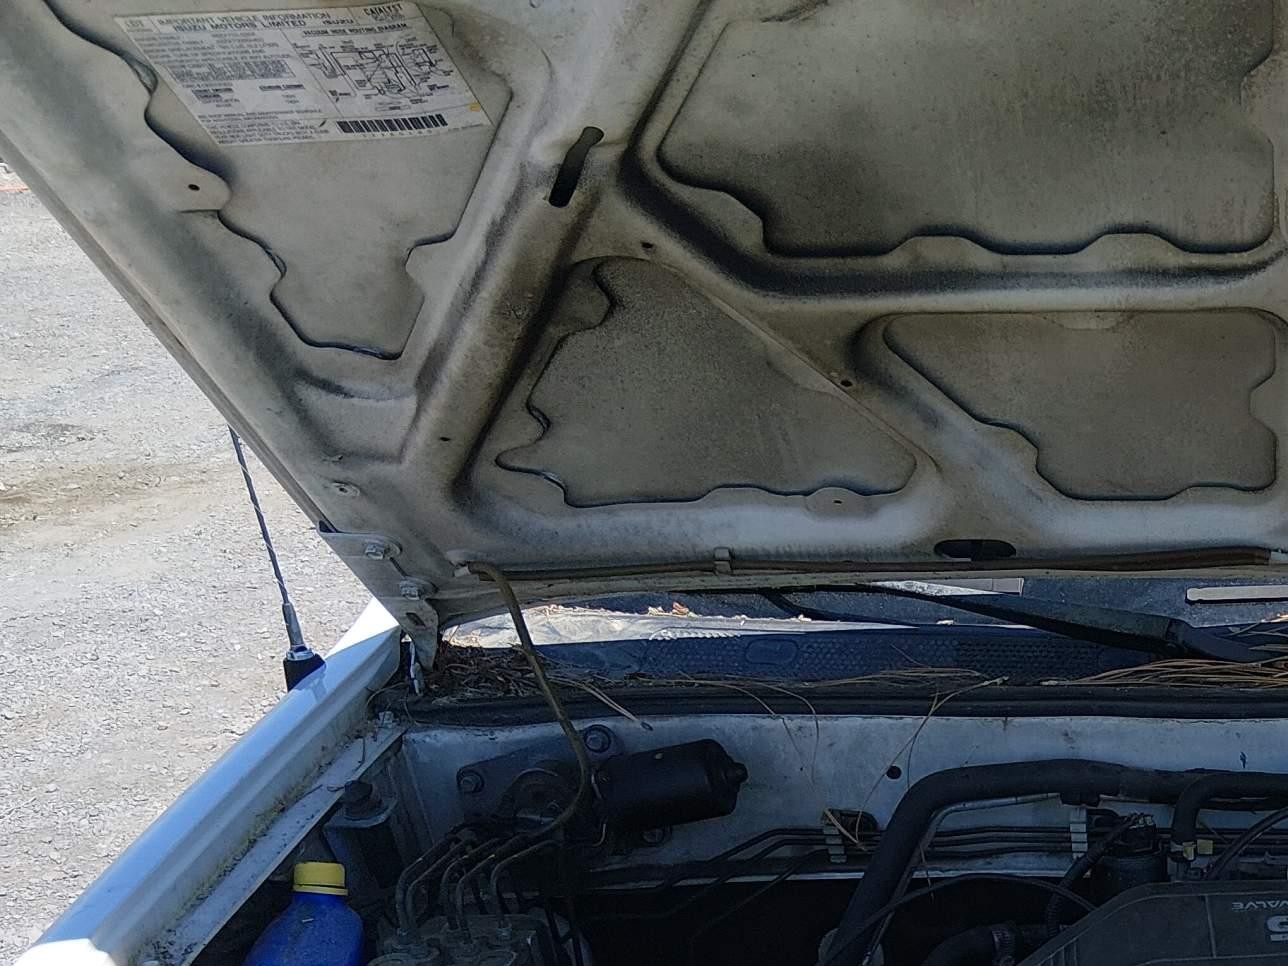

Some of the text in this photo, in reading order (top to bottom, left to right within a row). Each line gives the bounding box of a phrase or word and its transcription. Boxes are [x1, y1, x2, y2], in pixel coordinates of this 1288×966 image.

[363, 3, 403, 16] CATALYST
[172, 20, 307, 32] ISUZU MOTORS LIMITED
